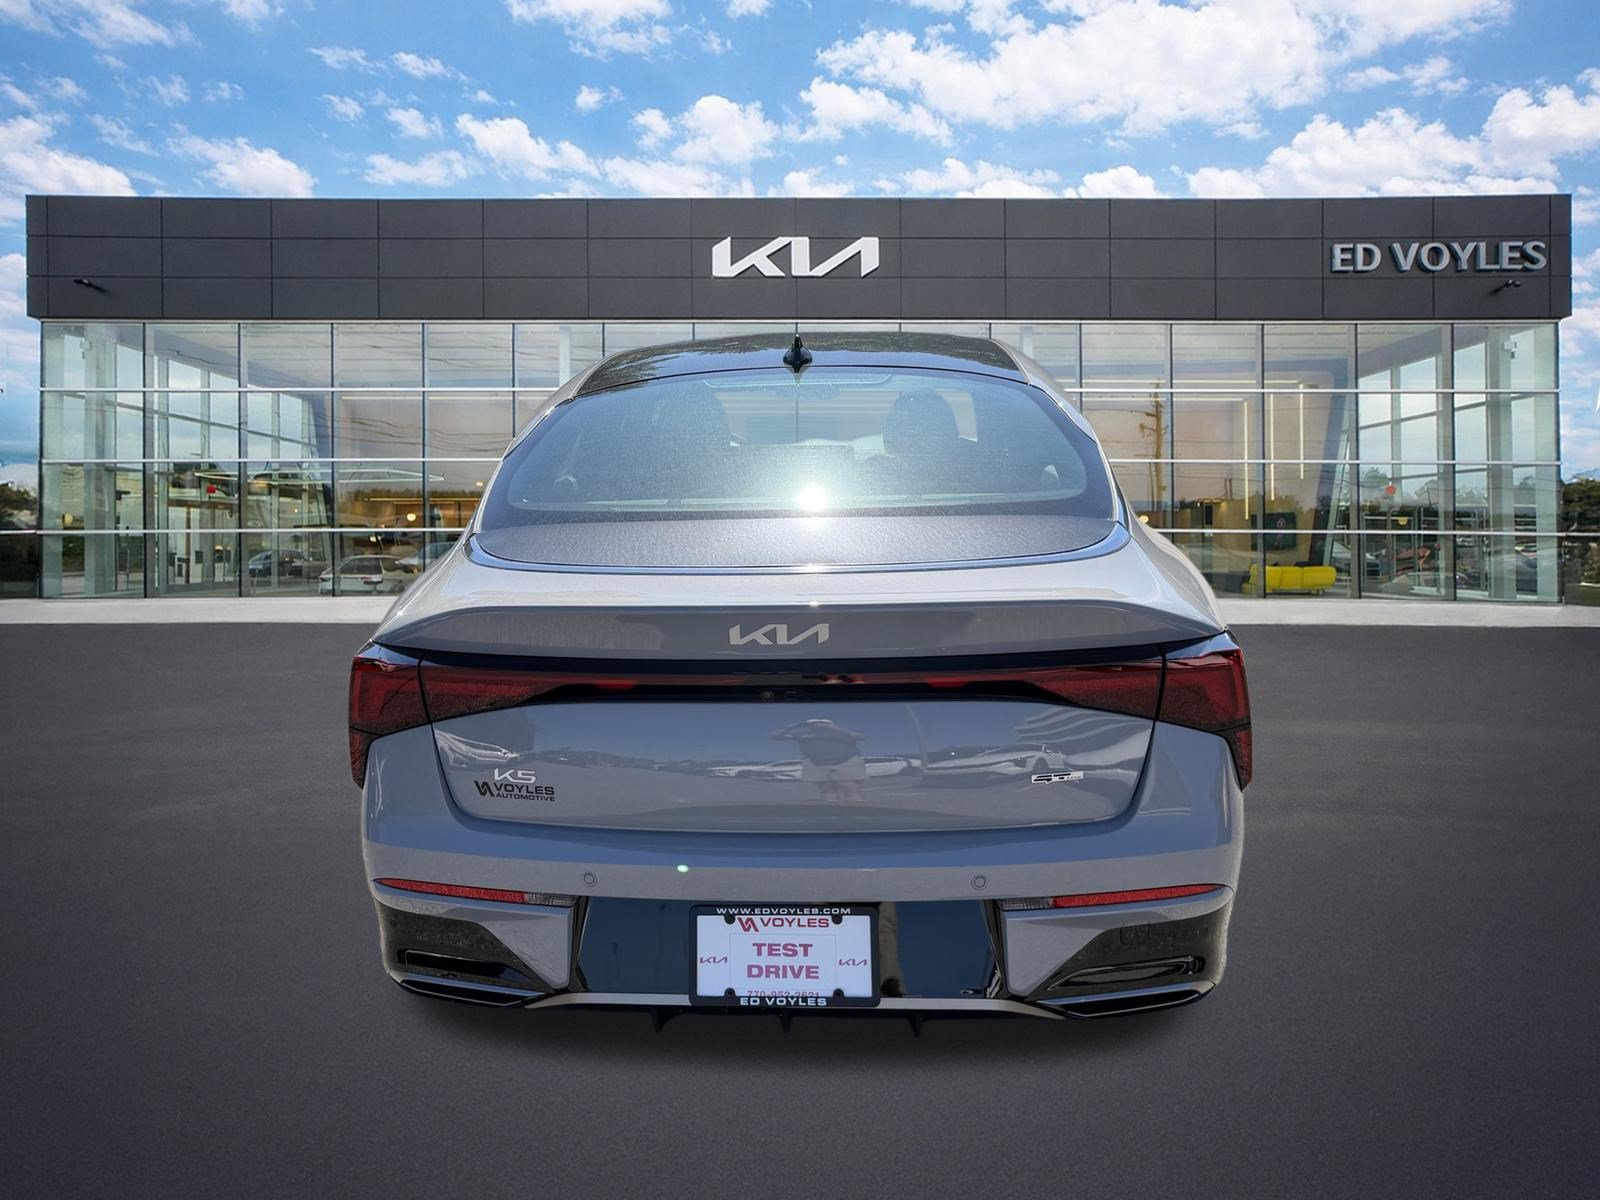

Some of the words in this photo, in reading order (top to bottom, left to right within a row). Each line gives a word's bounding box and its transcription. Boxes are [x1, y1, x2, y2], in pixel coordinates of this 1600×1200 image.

[712, 236, 880, 278] KIA
[1332, 243, 1382, 272] ED
[1391, 240, 1547, 271] VOYLES
[729, 623, 830, 645] KIA
[494, 768, 536, 784] K5
[493, 782, 555, 796] VOYLES
[496, 792, 556, 802] AUTOMOTIVE
[716, 907, 851, 915] WWW.EDVOYLES.COM
[760, 917, 830, 928] VOYLES
[752, 943, 813, 957] TEST
[746, 964, 820, 979] DRIVE
[740, 997, 760, 1006] ED
[765, 997, 827, 1006] VOYLES
